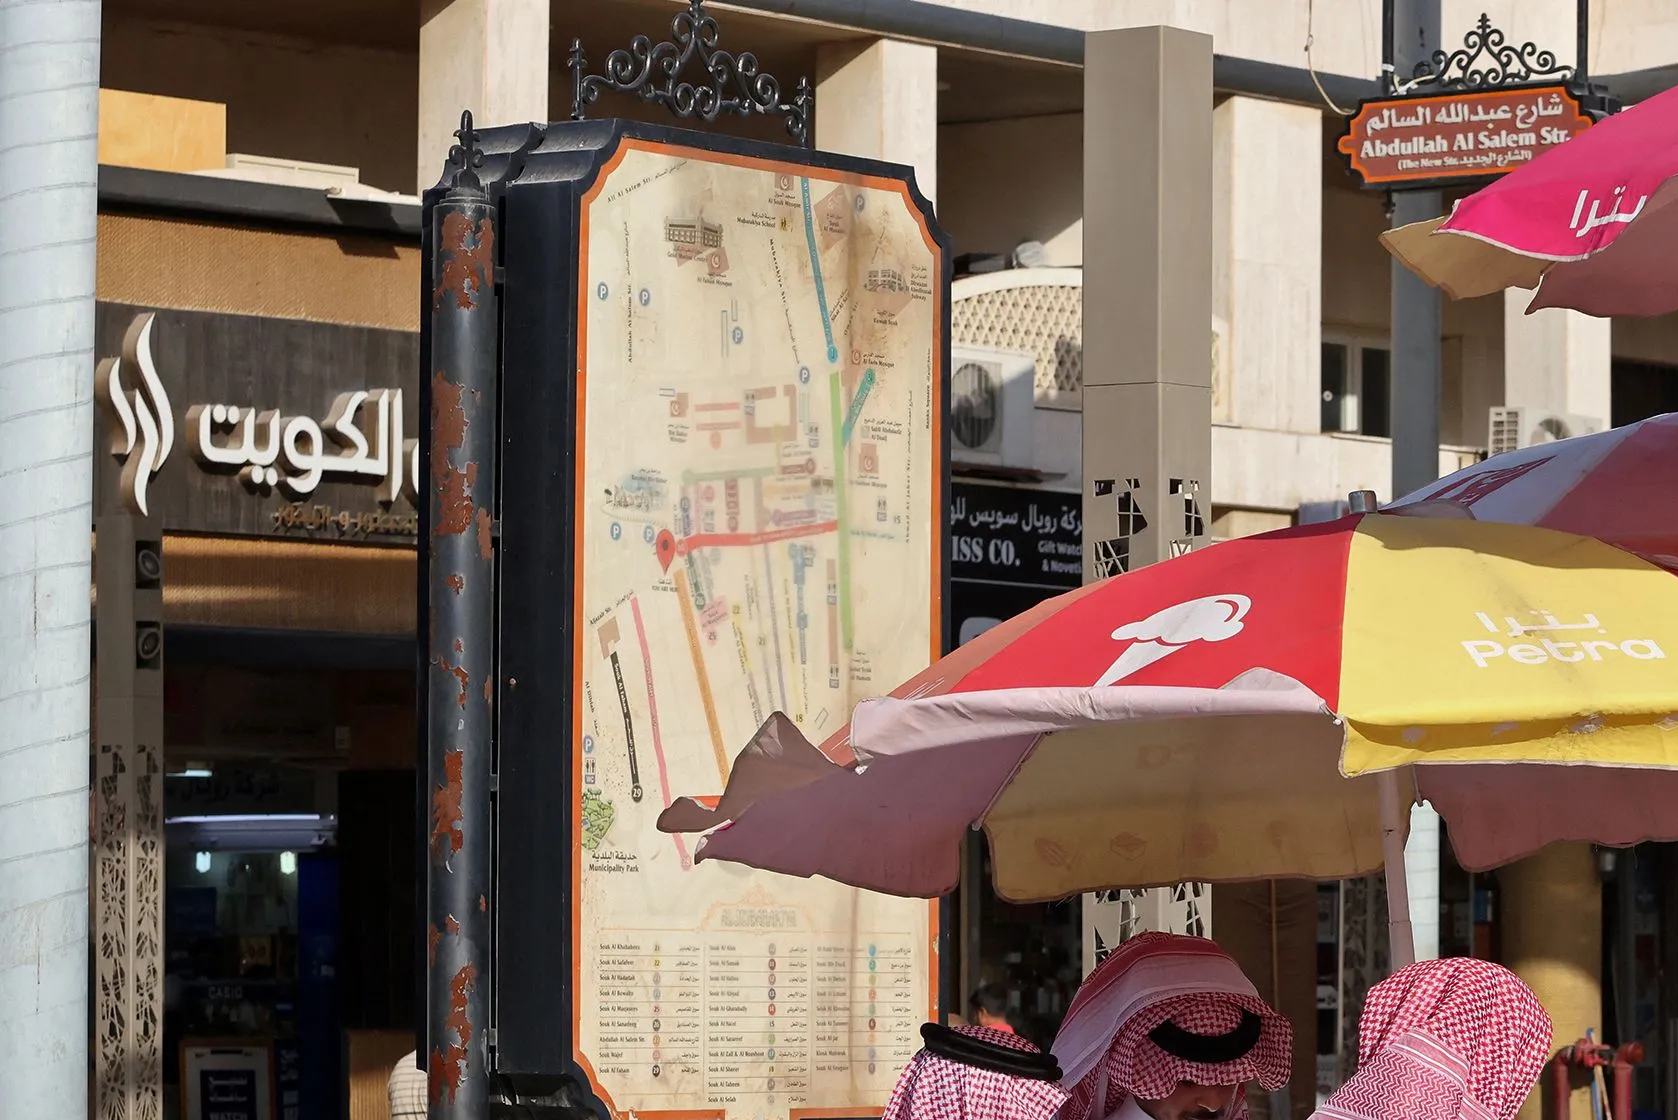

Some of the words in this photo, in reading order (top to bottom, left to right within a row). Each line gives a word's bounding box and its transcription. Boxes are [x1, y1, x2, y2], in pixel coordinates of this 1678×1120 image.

[1366, 106, 1431, 136] السالم
[1435, 103, 1512, 129] عبدالله
[1516, 93, 1563, 128] شارع
[1360, 136, 1448, 158] Abdullah
[1452, 133, 1474, 150] Al
[1478, 130, 1536, 149] Salem
[1540, 127, 1571, 144] Str.
[1397, 159, 1420, 170] (The
[1421, 158, 1442, 168] New
[199, 387, 403, 502] الكويت
[969, 510, 1019, 529] سويس
[1021, 503, 1058, 533] رويال
[988, 538, 1020, 567] CO.
[1474, 609, 1608, 638] بترا
[1460, 638, 1667, 668] Petra
[632, 787, 642, 799] 29
[589, 863, 625, 875] Municipality
[626, 864, 639, 873] Park
[591, 850, 615, 861] البلدية
[615, 852, 637, 861] حديقة
[208, 985, 243, 999] CASIO
